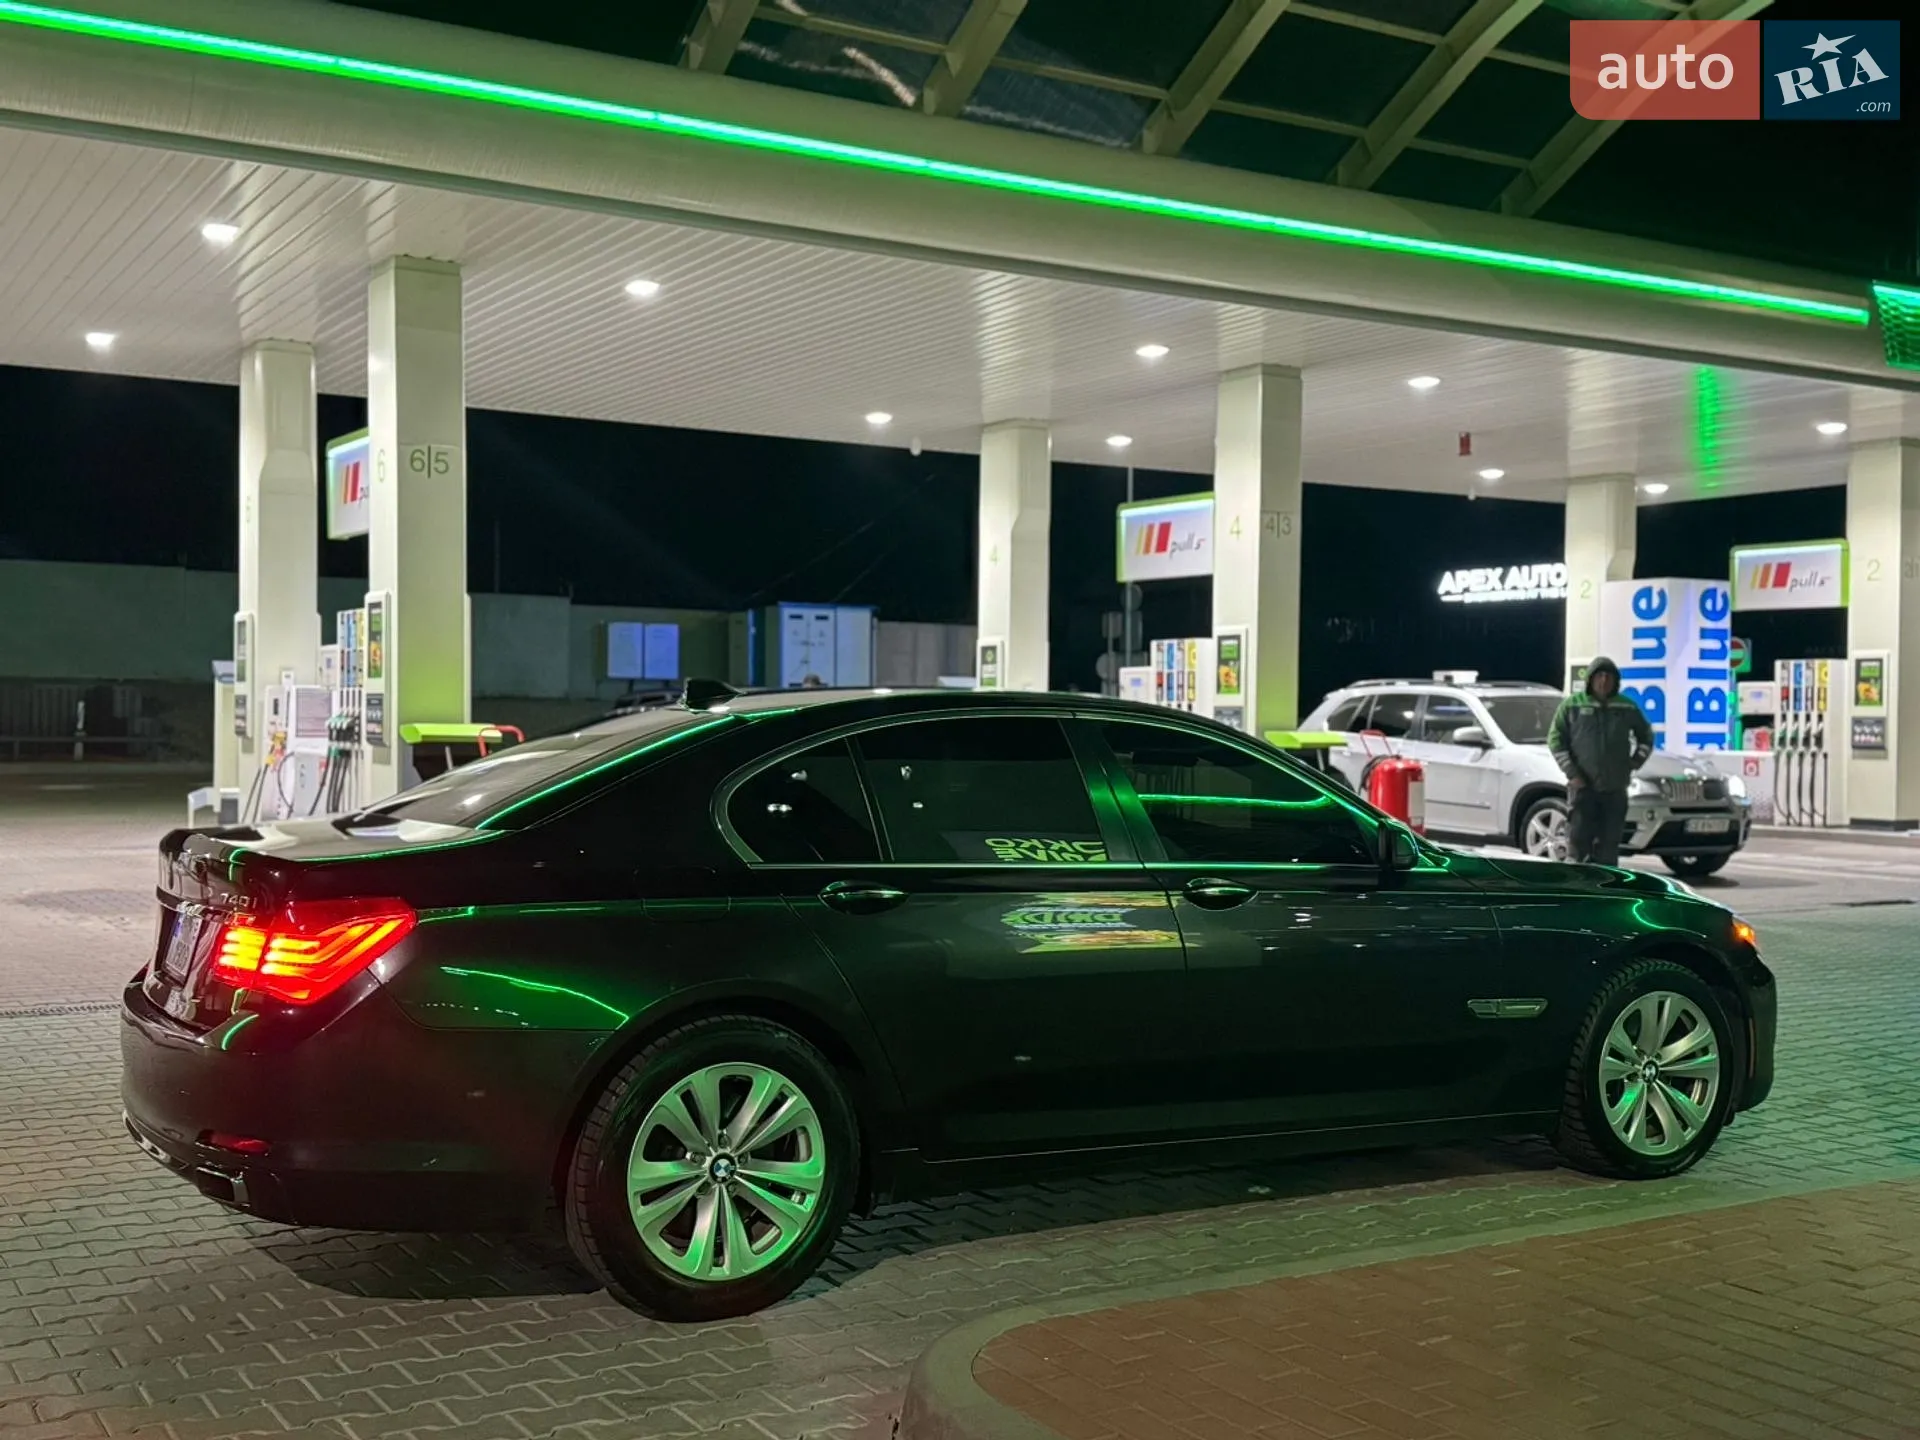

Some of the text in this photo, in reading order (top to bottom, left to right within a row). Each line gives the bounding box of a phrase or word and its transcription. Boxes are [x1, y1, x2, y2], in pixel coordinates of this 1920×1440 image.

[1229, 515, 1242, 540] 4
[1437, 562, 1567, 595] APEX AUTO
[1866, 558, 1882, 582] 2
[1580, 580, 1592, 600] 2
